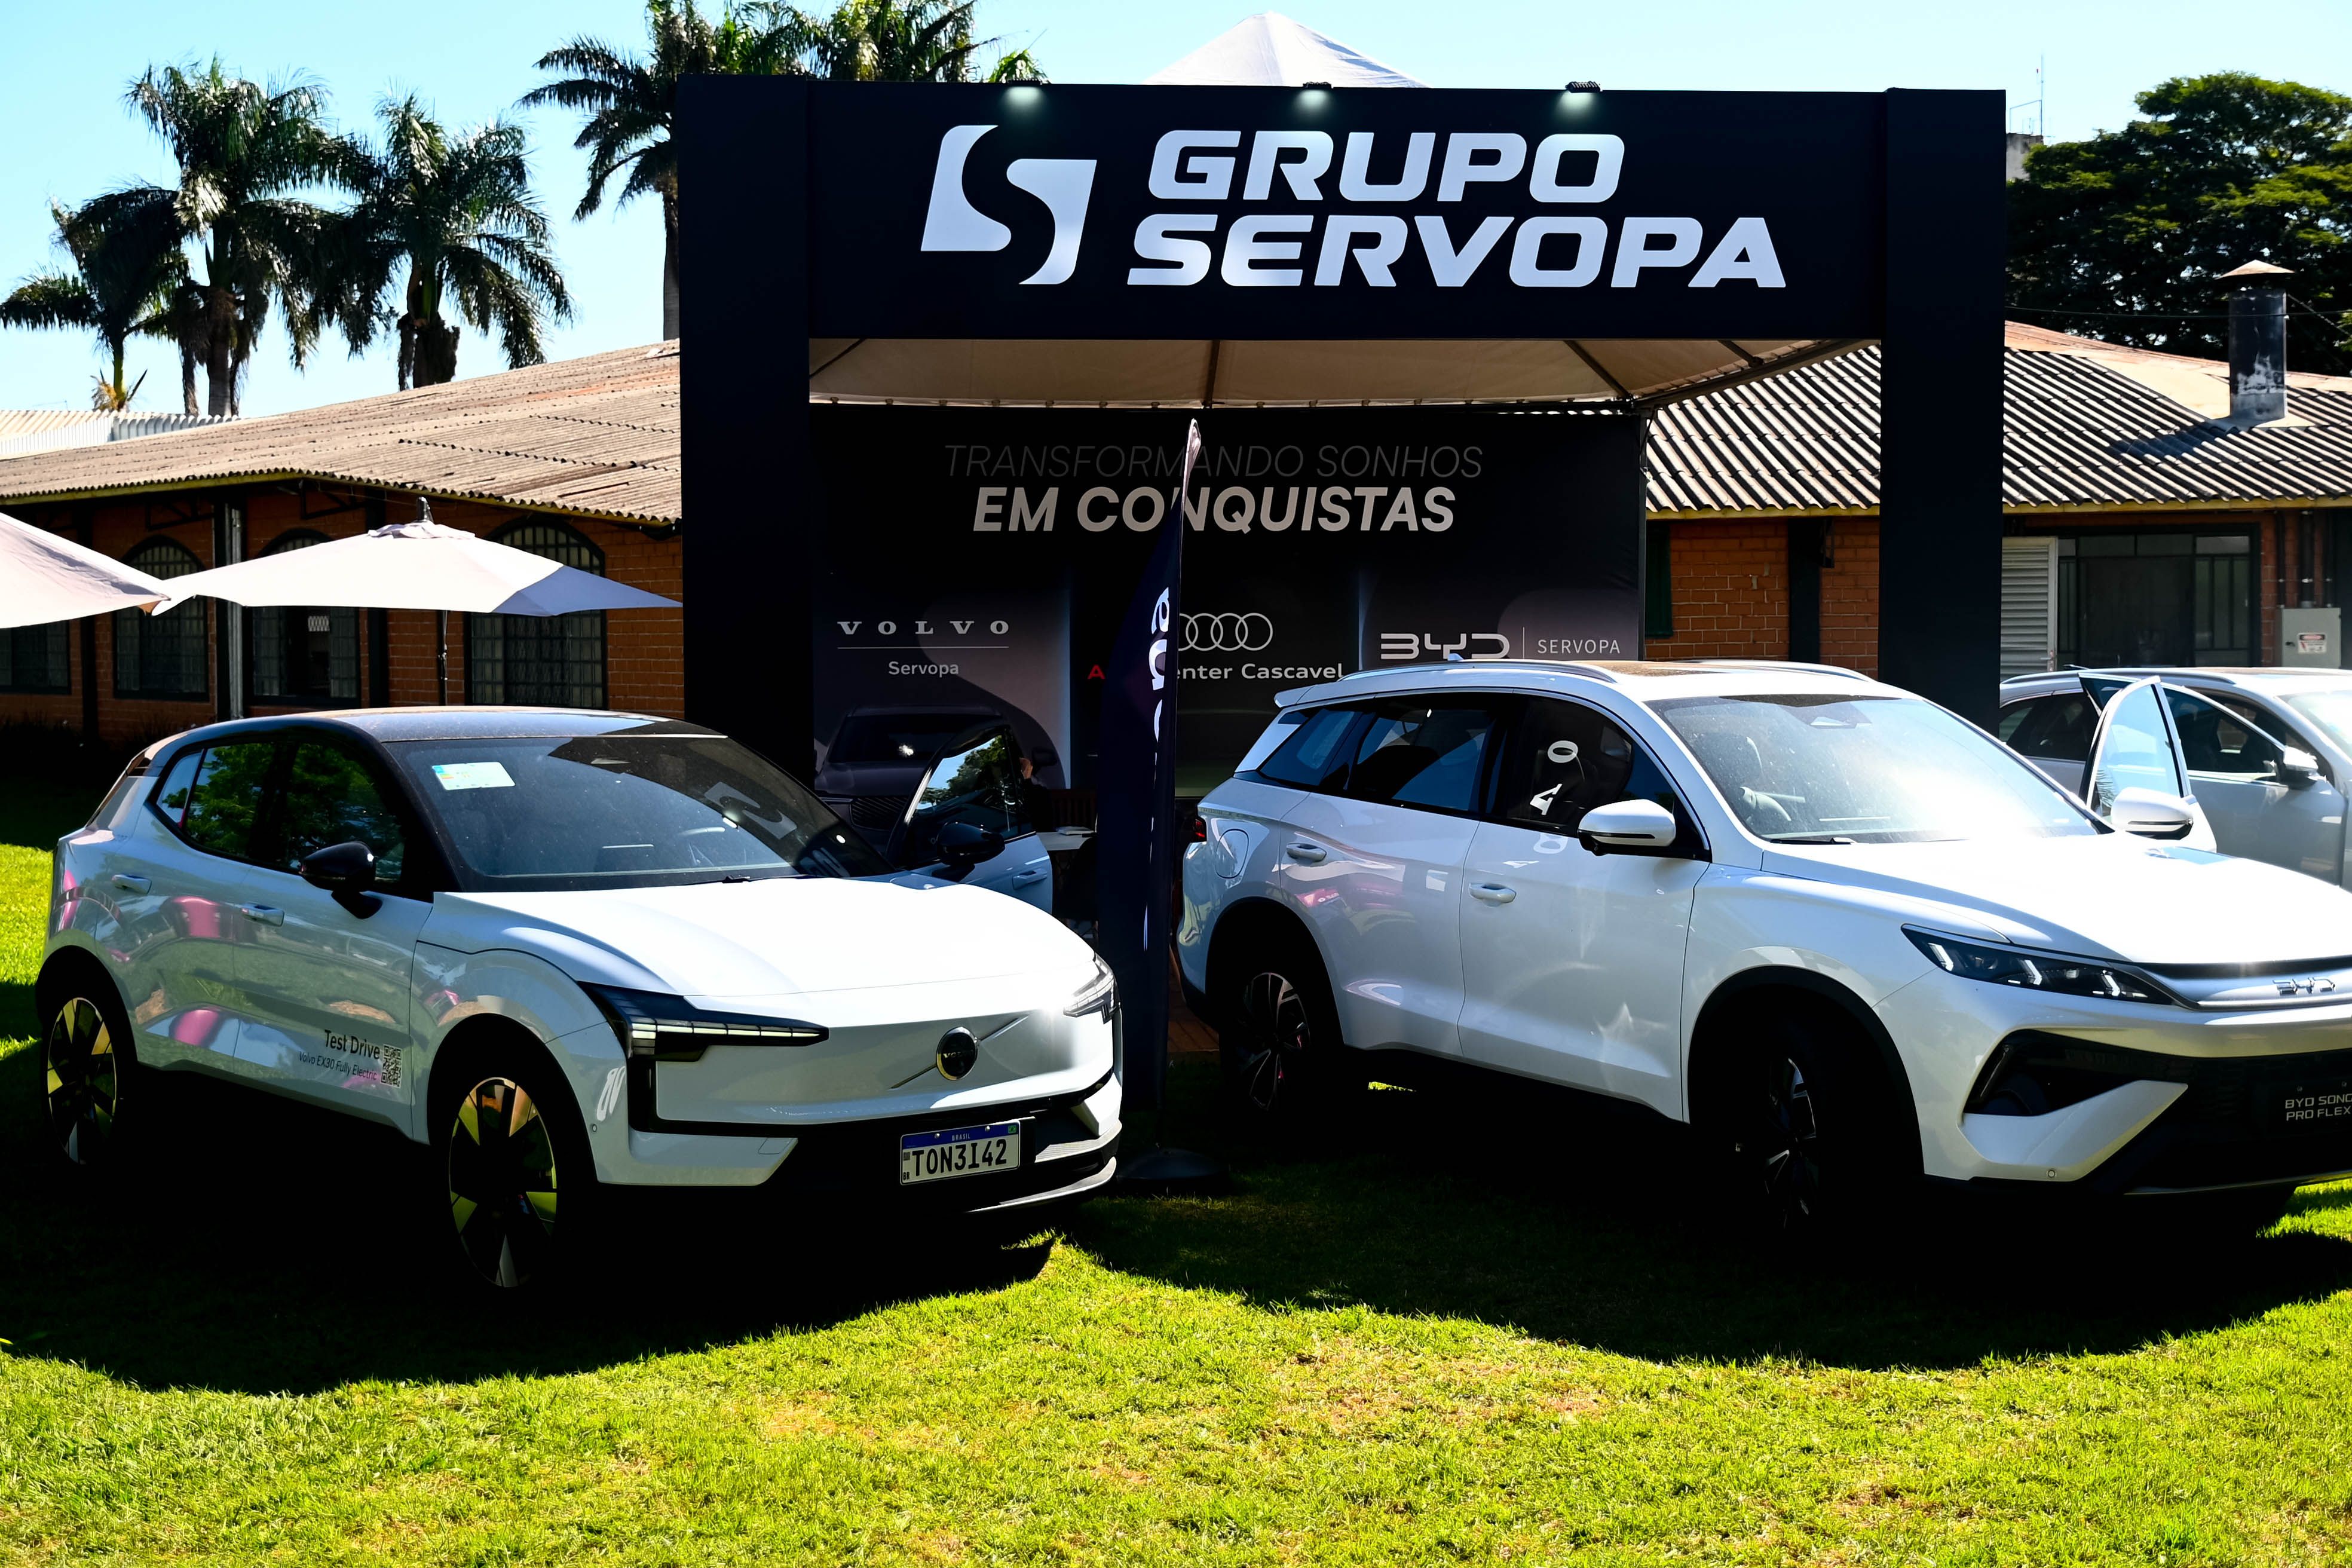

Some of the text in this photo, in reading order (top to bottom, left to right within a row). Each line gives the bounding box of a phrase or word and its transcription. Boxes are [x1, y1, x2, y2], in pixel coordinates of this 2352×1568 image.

[1149, 130, 1625, 203] GRUPO
[1127, 213, 1786, 288] SERVOPA
[944, 445, 1483, 477] TRANSFORMANDO SONHOS
[973, 486, 1456, 534] EM CONQUISTAS
[837, 620, 1009, 635] VOLVO
[1380, 633, 1621, 660] BYD SERVOPA
[888, 660, 958, 678] Servopa
[1241, 662, 1345, 680] Cascavel
[324, 1030, 381, 1059] Test Drive
[299, 1051, 378, 1081] Volvo EX30 Fully Electric
[2285, 1097, 2314, 1109] BYD
[2286, 1105, 2351, 1121] PRO FLEX
[951, 1133, 971, 1141] BRASIL
[912, 1139, 1007, 1177] TON3I42
[903, 1172, 910, 1181] BR
